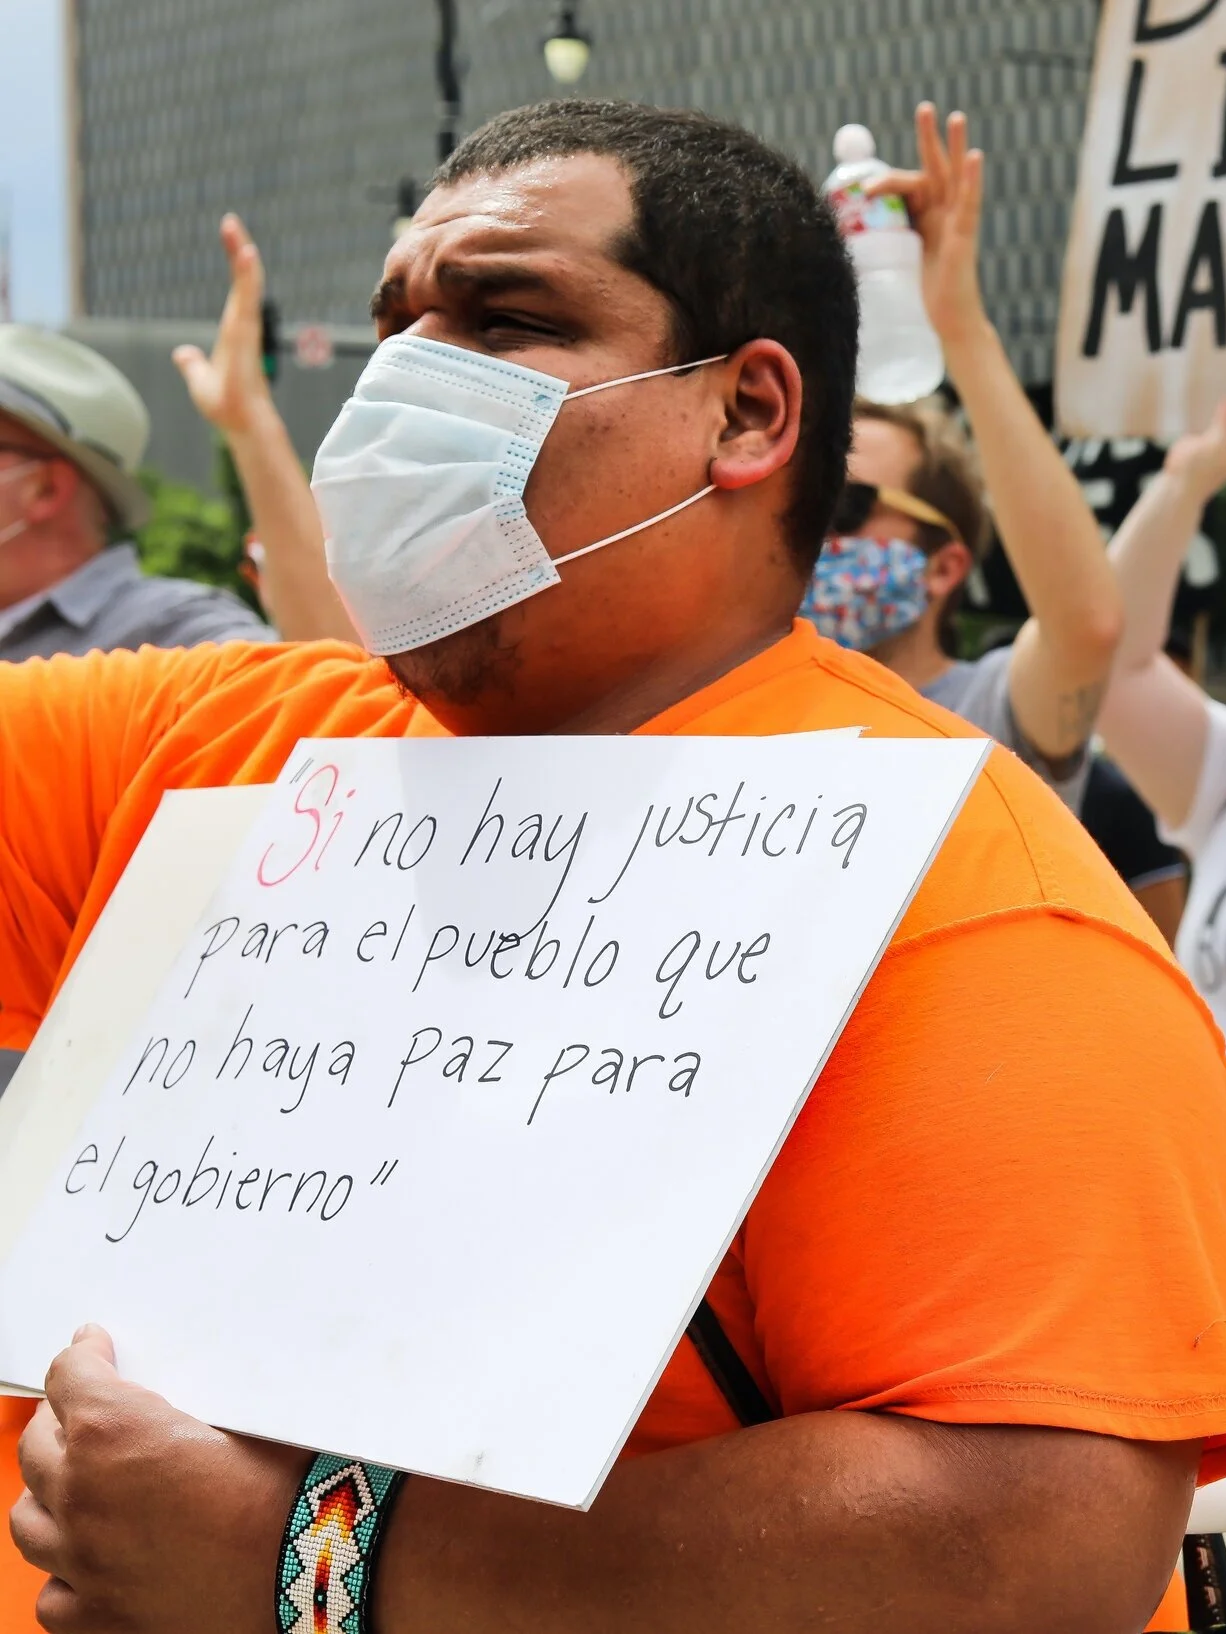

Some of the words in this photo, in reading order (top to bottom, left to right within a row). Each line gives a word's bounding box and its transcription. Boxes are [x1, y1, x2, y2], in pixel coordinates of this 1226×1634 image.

[354, 812, 437, 871] no
[460, 777, 588, 936] hay
[587, 781, 867, 904] justicia
[184, 915, 330, 999] para
[357, 904, 415, 962] el
[412, 914, 619, 992] pueblo
[656, 930, 771, 1019] que
[122, 1037, 196, 1097] no
[216, 1003, 355, 1114] haya
[527, 1044, 701, 1125] para
[65, 1135, 126, 1194] el
